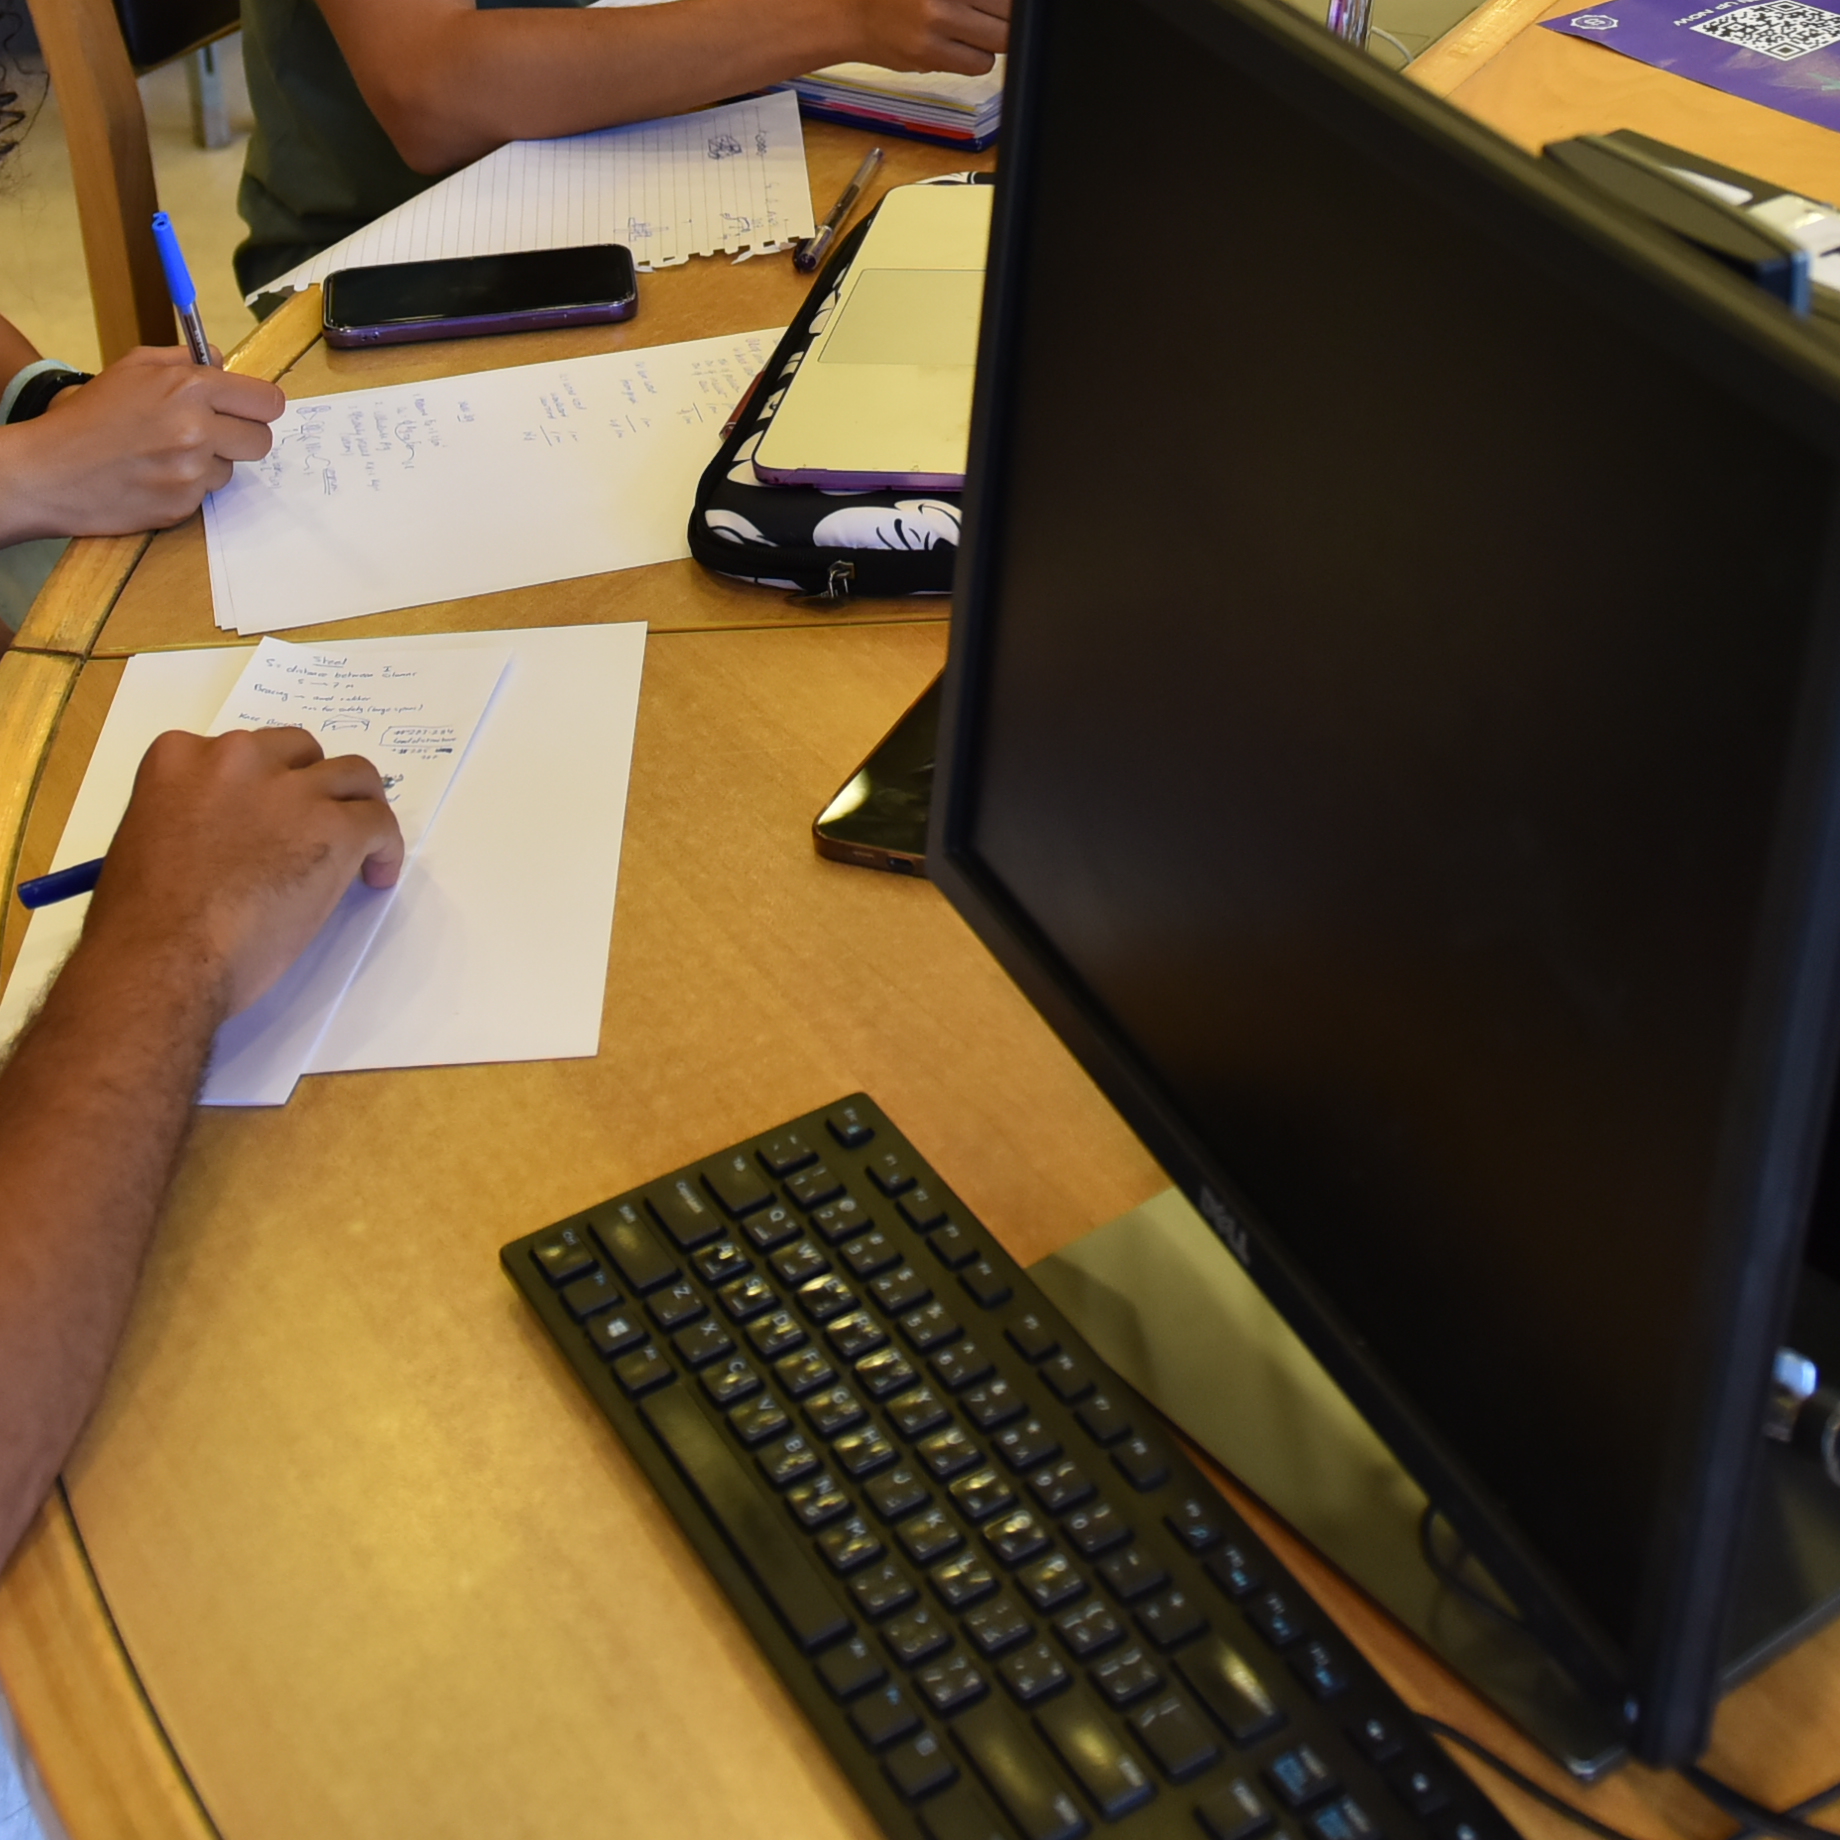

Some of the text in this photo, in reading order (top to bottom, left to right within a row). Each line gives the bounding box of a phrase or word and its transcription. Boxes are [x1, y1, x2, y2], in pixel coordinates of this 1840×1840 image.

[1715, 1, 1738, 11] UP
[1673, 8, 1715, 28] NOW
[312, 654, 348, 668] Steel
[1199, 1190, 1254, 1265] DELL
